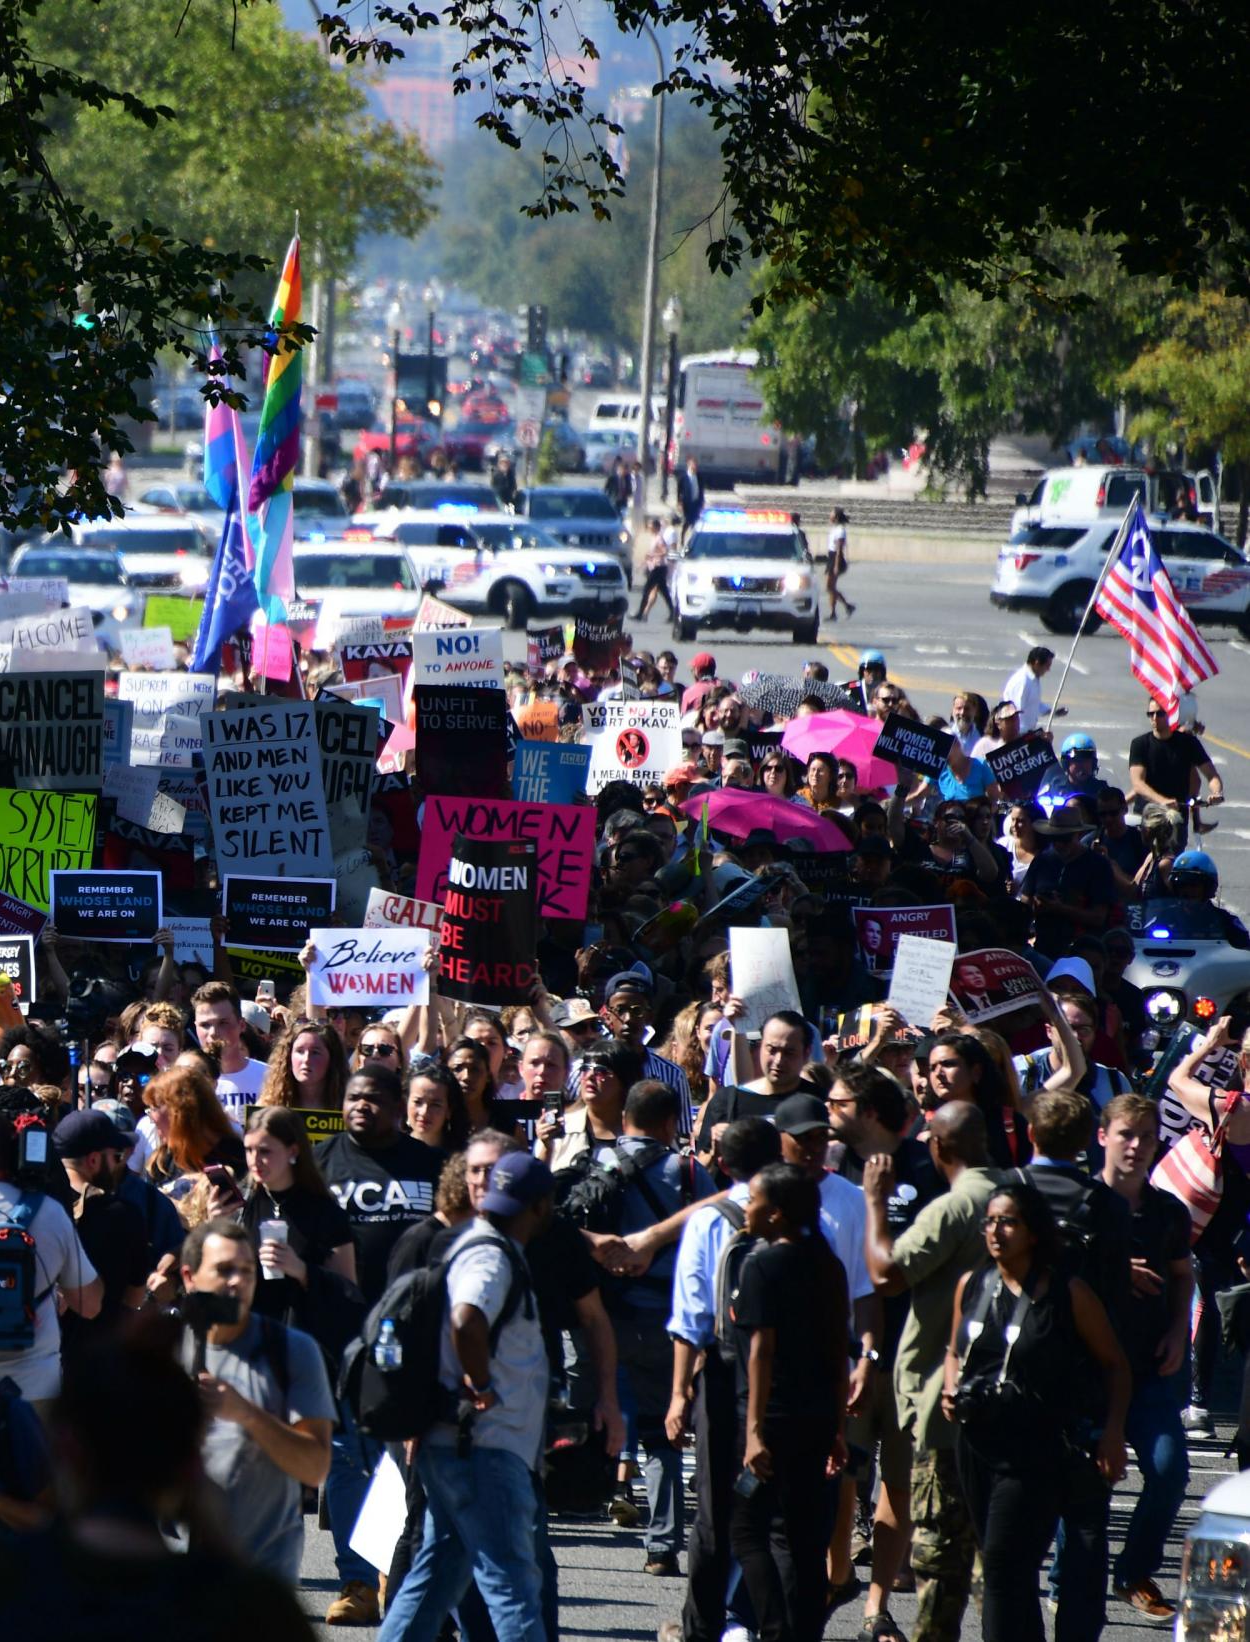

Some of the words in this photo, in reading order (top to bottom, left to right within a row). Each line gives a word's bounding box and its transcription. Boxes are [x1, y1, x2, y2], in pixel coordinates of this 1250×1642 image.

[436, 635, 480, 656] NO!
[424, 664, 441, 674] TO
[445, 659, 496, 673] ANYONE
[421, 697, 478, 712] UNFIT
[586, 706, 625, 719] VOTE
[651, 707, 676, 719] FOR
[220, 716, 276, 742] WAS
[421, 714, 441, 730] TO
[591, 718, 623, 728] BART
[877, 734, 901, 754] WILL
[894, 727, 936, 751] WOMEN
[212, 751, 252, 772] AND
[257, 746, 308, 767] MEN
[521, 749, 551, 777] WE
[991, 744, 1031, 770] UNFIT
[215, 776, 264, 798] LIKE
[267, 772, 310, 796] YOU
[600, 770, 628, 780] MEAN
[996, 767, 1014, 783] TO
[7, 790, 97, 851] SYSTEM
[219, 803, 271, 825] KEPT
[277, 801, 318, 822] ME
[435, 800, 582, 843] WOMEN
[221, 828, 325, 859] SILENT
[450, 858, 528, 891] WOMEN
[77, 886, 134, 894] REMEMBER
[251, 893, 308, 904] REMEMBER
[60, 896, 110, 906] WHOSE
[115, 896, 153, 906] LAND
[232, 902, 284, 915] WHOSE
[288, 906, 326, 918] LAND
[445, 890, 502, 924] MUST
[78, 910, 94, 918] WE
[97, 910, 112, 918] ARE
[114, 910, 135, 918] ON
[250, 917, 266, 926] WE
[269, 918, 290, 927] ARE
[292, 920, 308, 928] ON
[891, 912, 931, 923] ANGRY
[440, 922, 464, 950] BE
[320, 939, 416, 972] Believe
[438, 959, 534, 988] HEARD
